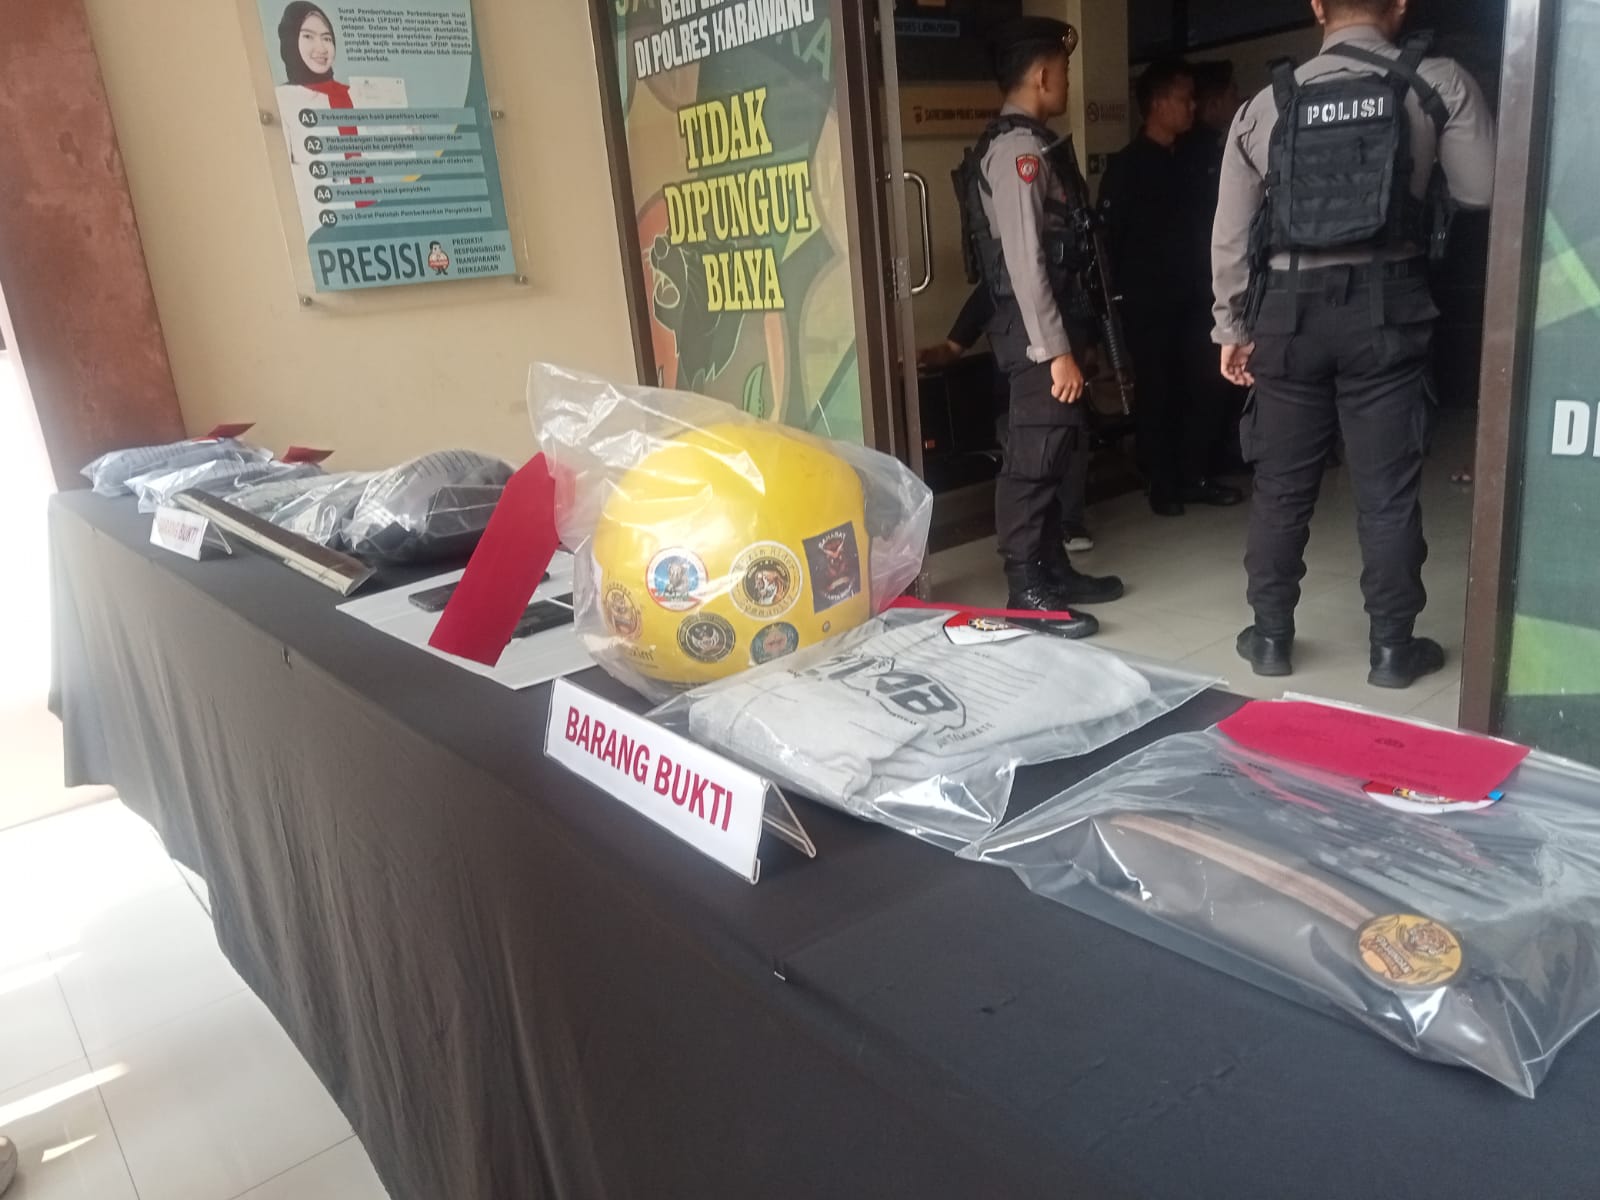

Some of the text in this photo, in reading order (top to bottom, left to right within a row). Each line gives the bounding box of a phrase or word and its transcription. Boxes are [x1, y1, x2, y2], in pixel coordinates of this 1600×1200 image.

[634, 0, 815, 80] DI POLRES KARAWANG
[302, 113, 316, 124] A1
[1307, 96, 1384, 124] POLISI
[306, 140, 322, 151] A2
[678, 87, 773, 170] TIDAK
[312, 164, 326, 176] A3
[316, 189, 331, 200] A4
[664, 160, 812, 245] DIPUNGUT
[321, 213, 336, 224] A5
[317, 242, 425, 286] PRESISI
[702, 248, 785, 312] BIAYA
[565, 705, 733, 832] BARANG BUKTI
